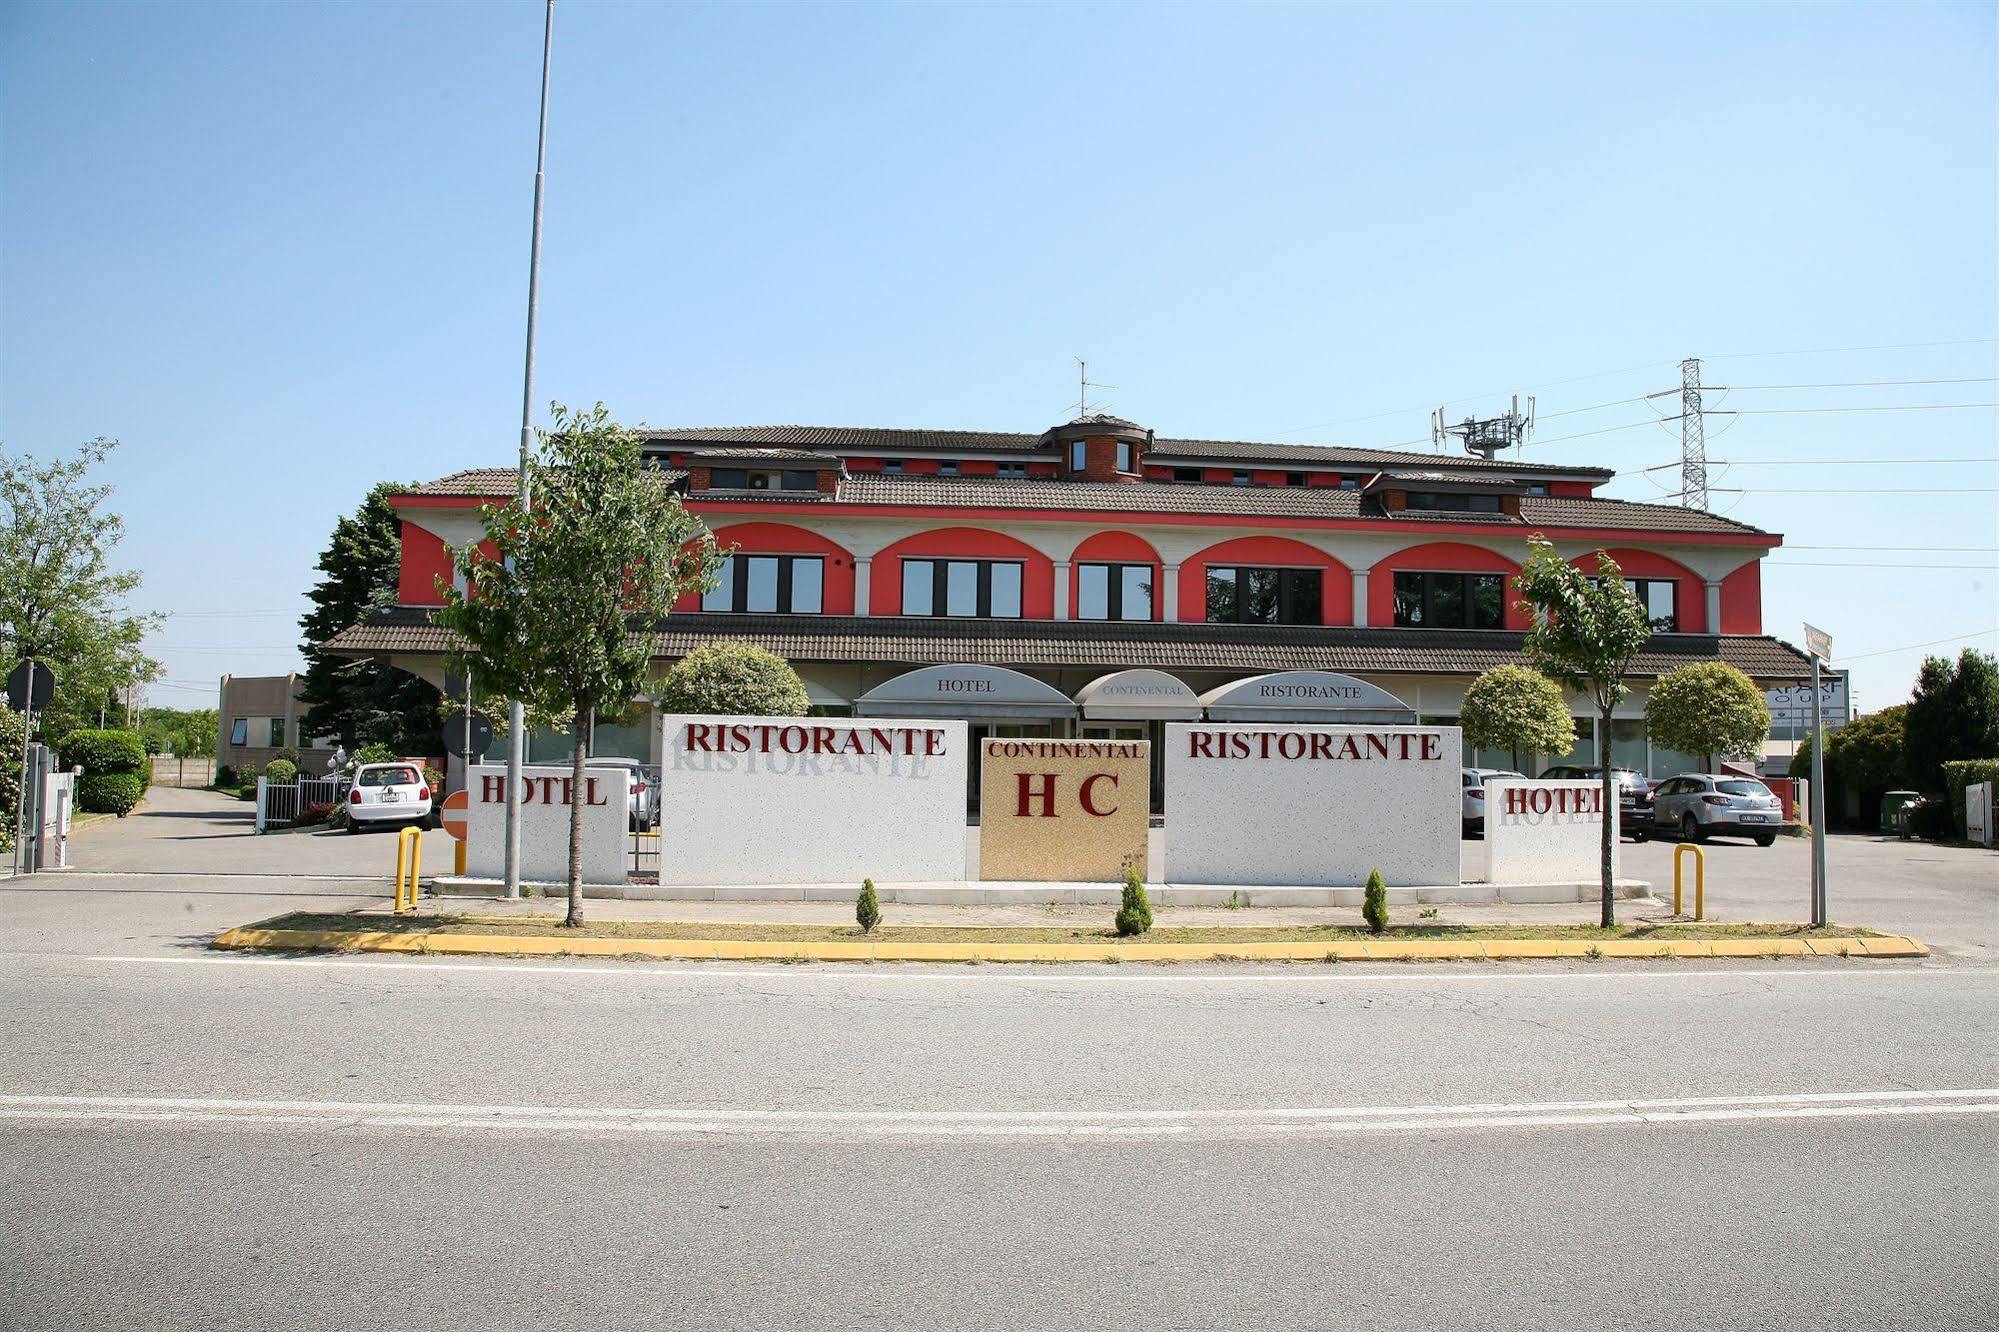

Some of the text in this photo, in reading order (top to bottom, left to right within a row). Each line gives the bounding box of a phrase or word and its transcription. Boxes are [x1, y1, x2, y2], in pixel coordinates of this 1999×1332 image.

[937, 679, 996, 692] HOTEL
[1102, 685, 1184, 696] CONTINENTAL
[1260, 685, 1362, 698] RISTORANTE
[684, 723, 947, 757] RISTORANTE
[1189, 731, 1443, 761] RISTORANTE
[987, 741, 1145, 759] CONTINENTAL
